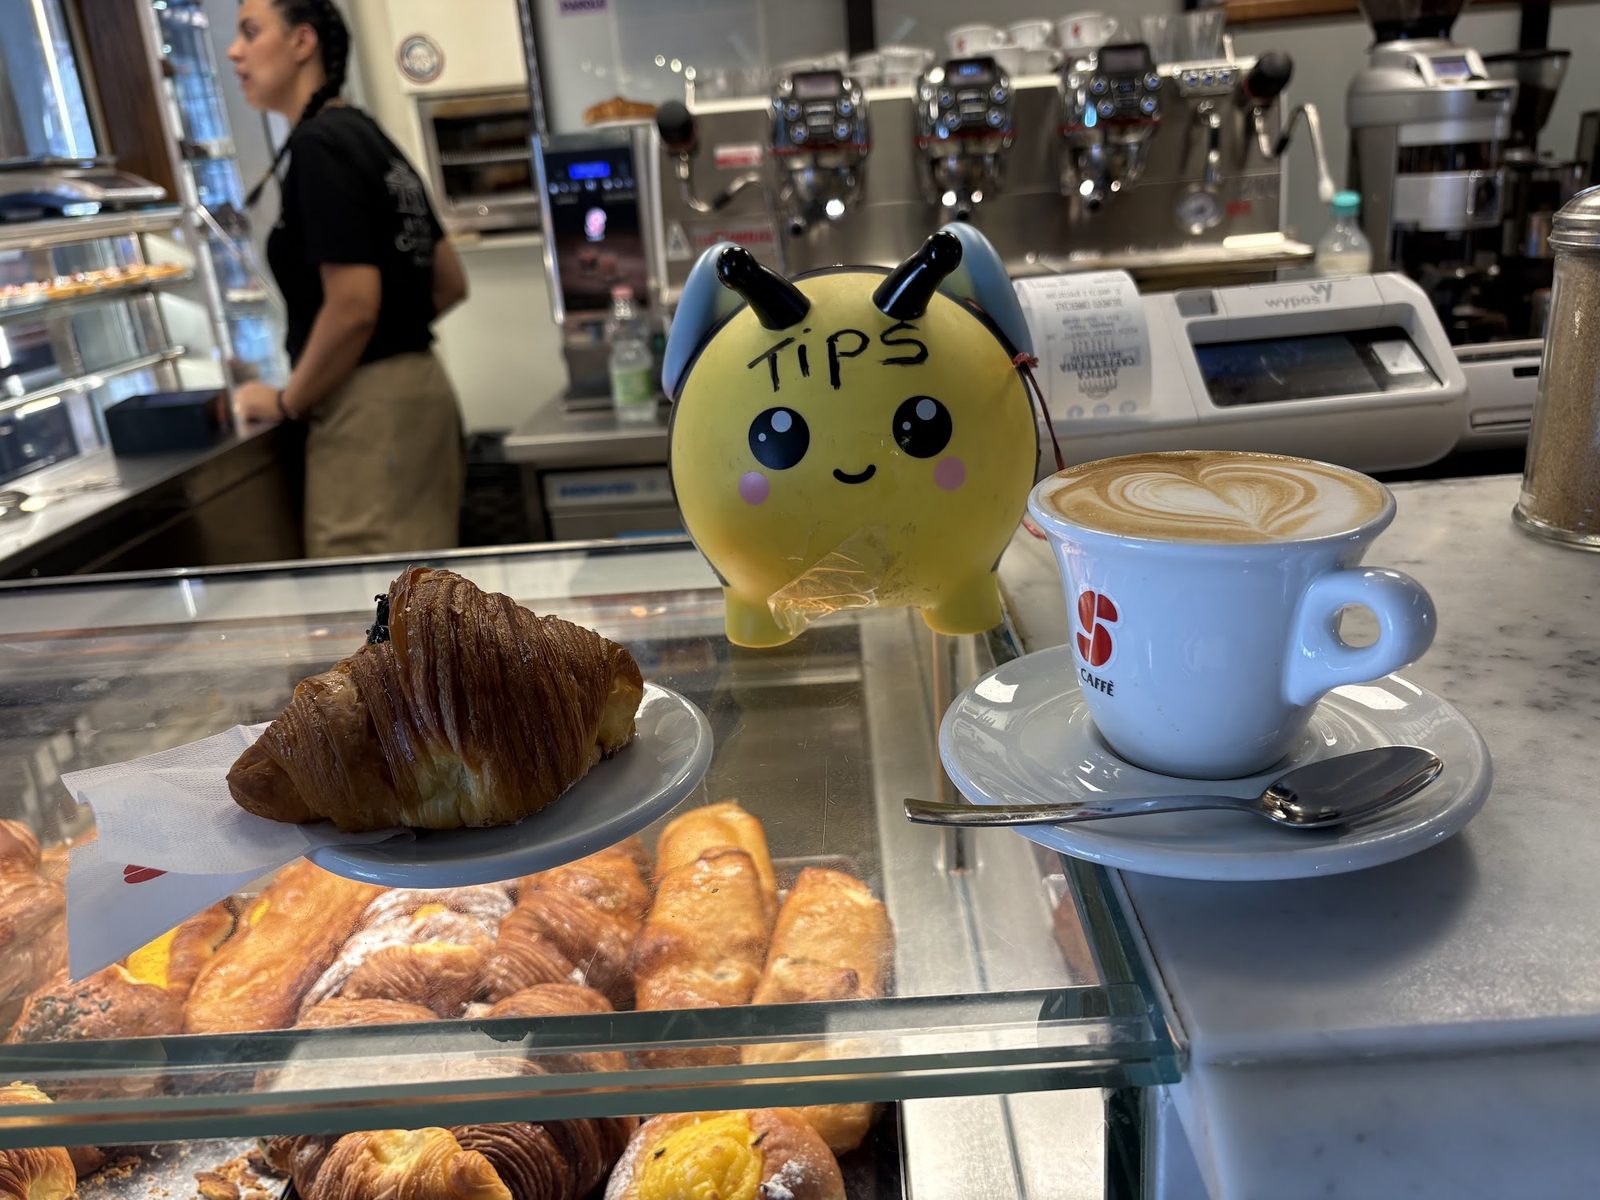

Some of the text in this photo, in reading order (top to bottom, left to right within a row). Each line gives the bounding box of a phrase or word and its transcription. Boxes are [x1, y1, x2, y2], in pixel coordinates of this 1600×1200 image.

[1265, 294, 1320, 309] wypos
[1060, 355, 1136, 373] CAFFETTERIA
[1076, 367, 1119, 380] ANTICA
[1081, 668, 1115, 697] CAFFÈ
